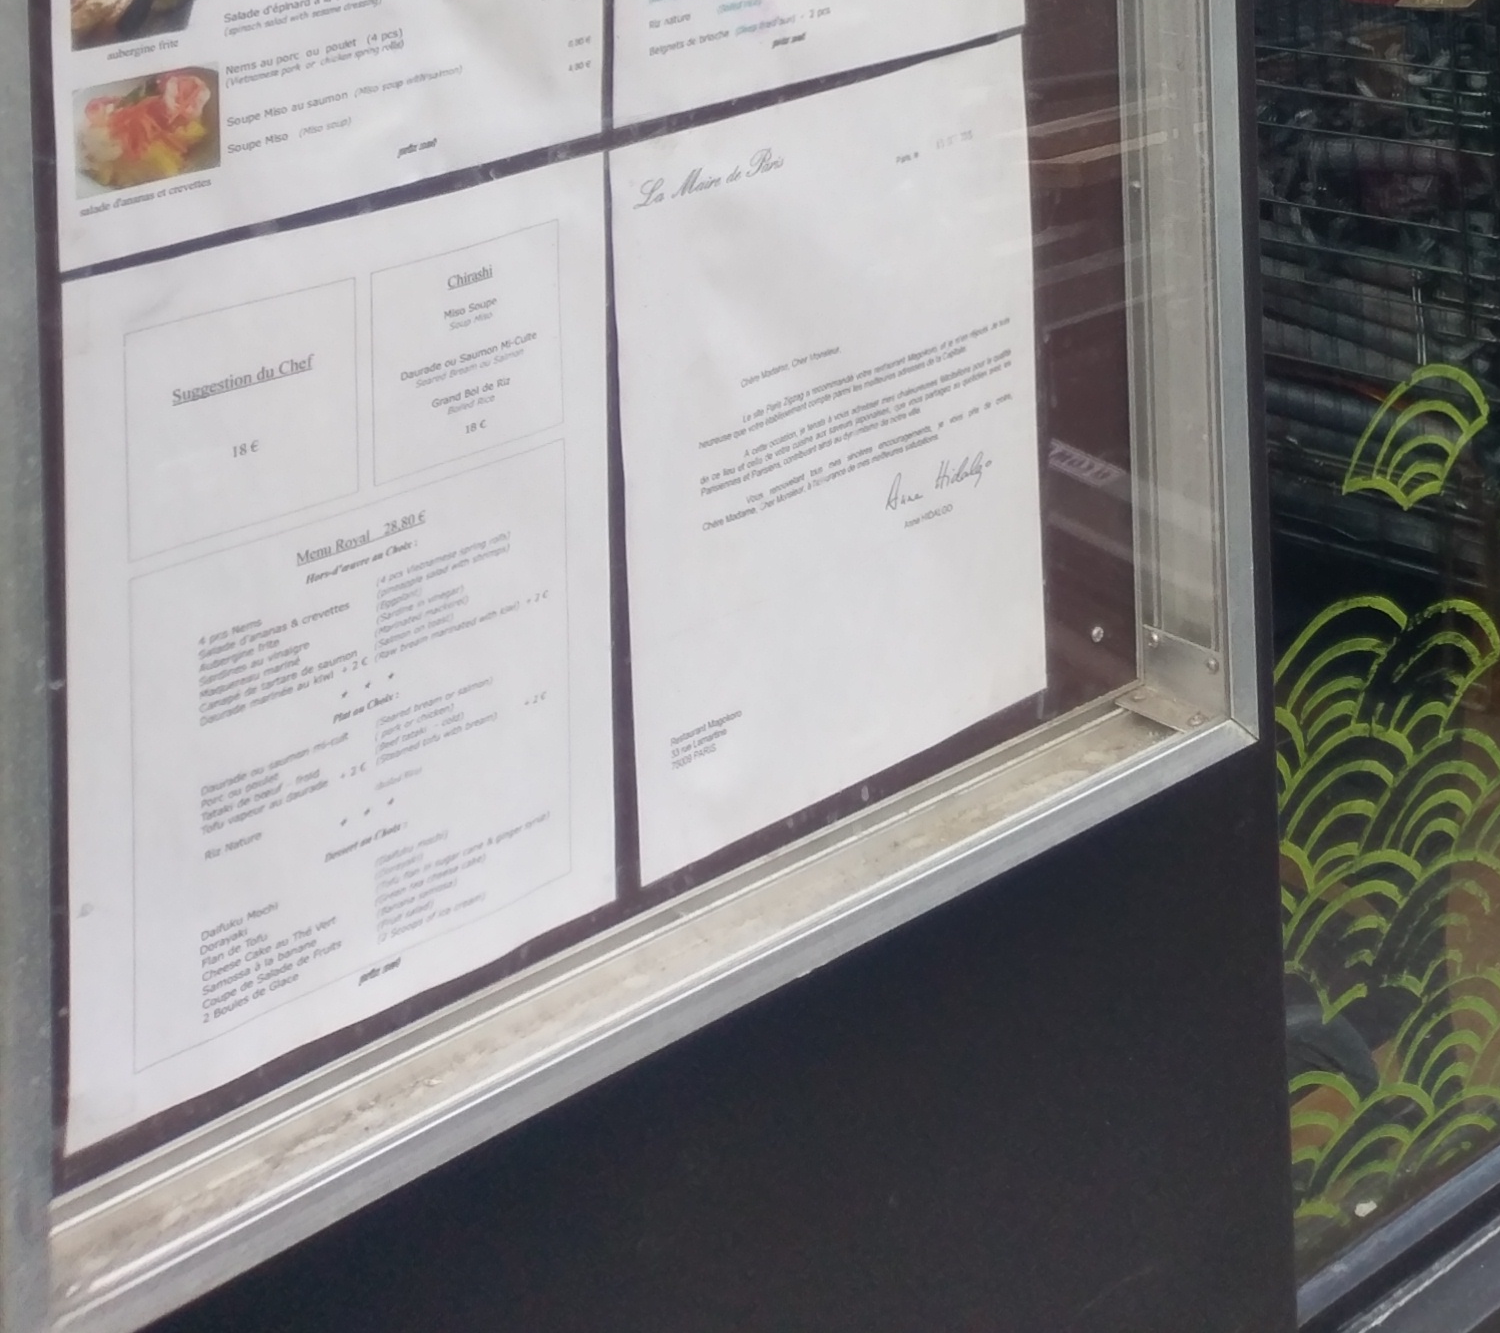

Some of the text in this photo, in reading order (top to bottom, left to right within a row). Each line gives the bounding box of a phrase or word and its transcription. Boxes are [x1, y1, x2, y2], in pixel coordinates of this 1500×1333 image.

[107, 39, 179, 61] aubergine frite
[226, 92, 348, 127] Soupe Miso au saumon
[632, 147, 784, 210] La Maire de Paris
[79, 179, 212, 217] salade d'ananas et crevettes
[447, 266, 493, 290] Chirashi
[172, 355, 314, 405] Suggestion du Chef
[232, 439, 259, 458] 18 €
[296, 510, 427, 566] Menu Royal 28,80 €
[200, 928, 248, 955] Dorayaki
[201, 917, 244, 941] Daifuku
[202, 933, 268, 968] Flan de Tofu
[202, 958, 242, 981] Cheese
[245, 945, 272, 962] Cake
[275, 939, 289, 949] au
[292, 927, 312, 941] Thé
